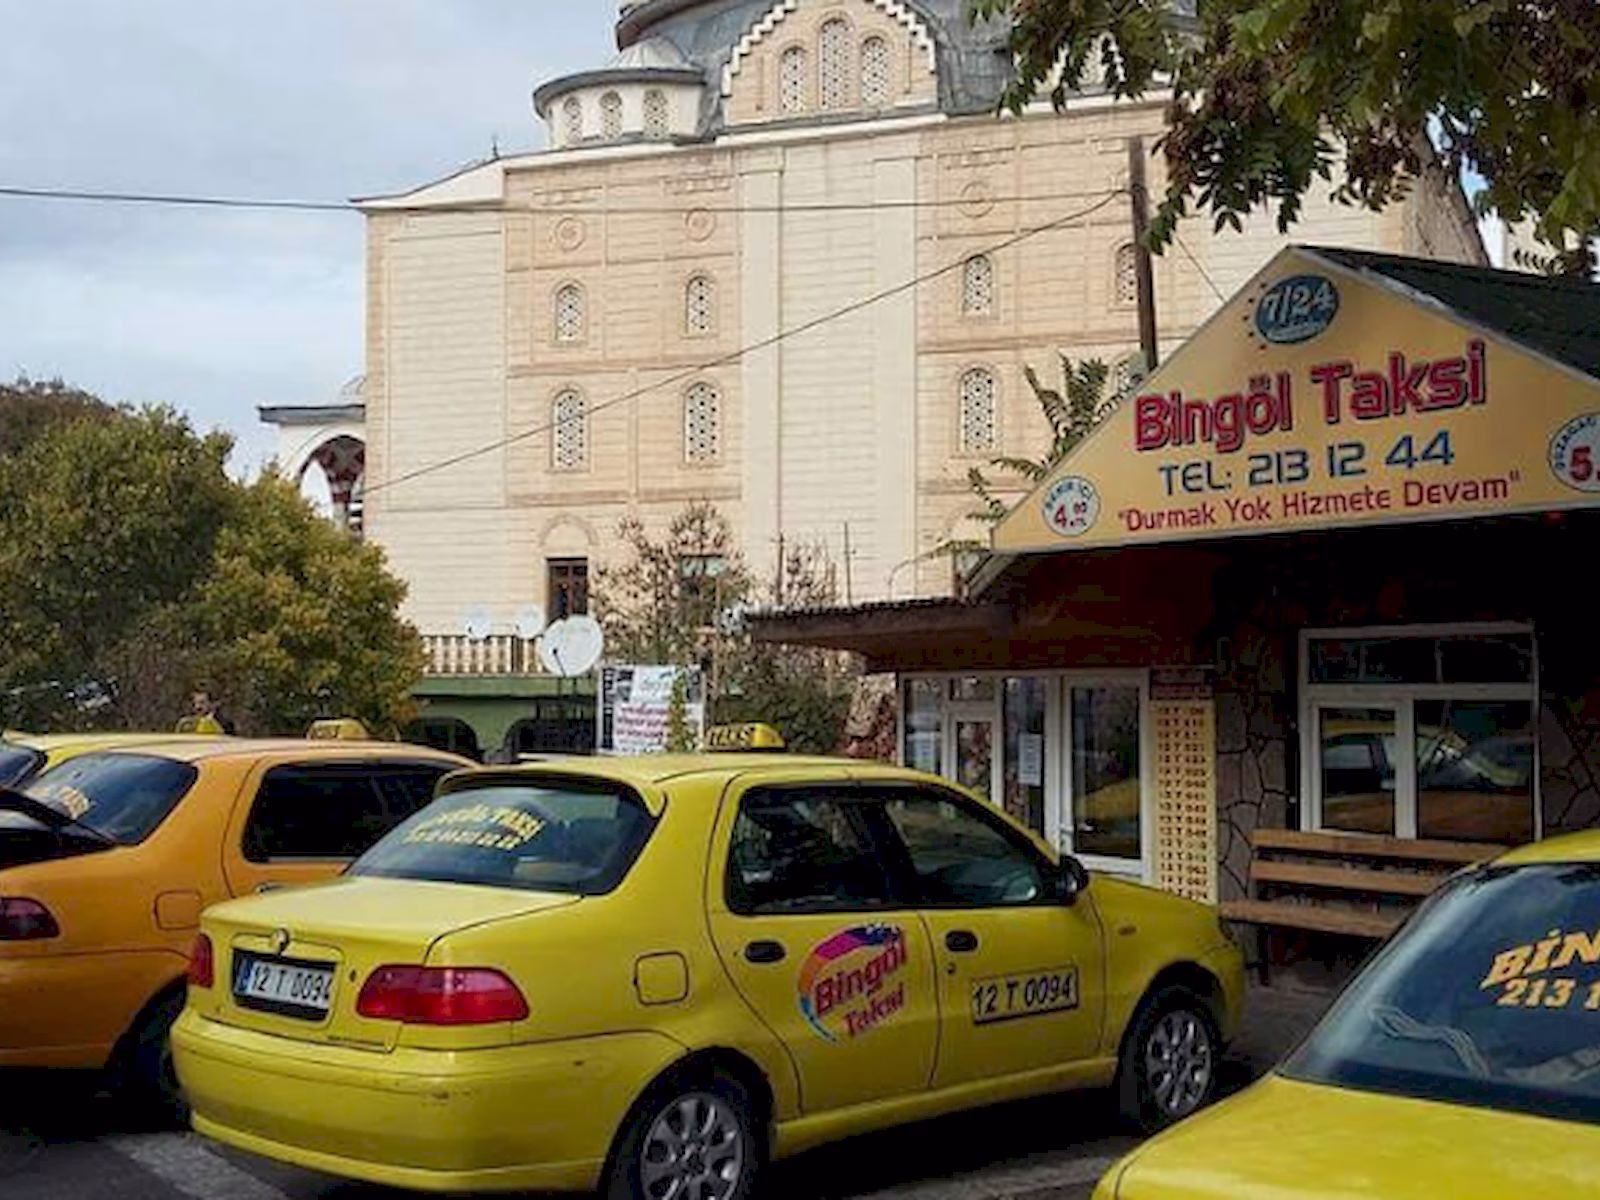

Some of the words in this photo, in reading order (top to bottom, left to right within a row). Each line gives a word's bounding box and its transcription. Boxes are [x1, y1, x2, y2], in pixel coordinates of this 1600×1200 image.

[1135, 371, 1293, 452] Bingöl
[1311, 340, 1485, 424] Taksi
[1159, 462, 1232, 495] TEL:
[1248, 449, 1309, 486] 213
[1326, 443, 1367, 477] 12
[1385, 431, 1455, 469] 44
[1224, 496, 1271, 522] Yok
[1283, 486, 1392, 517] Hizmete
[253, 965, 270, 991] 12
[277, 969, 286, 993] T
[974, 985, 997, 1015] 12
[1007, 979, 1018, 1009] T
[1024, 973, 1074, 1008] 0094
[1497, 978, 1576, 1007] 213
